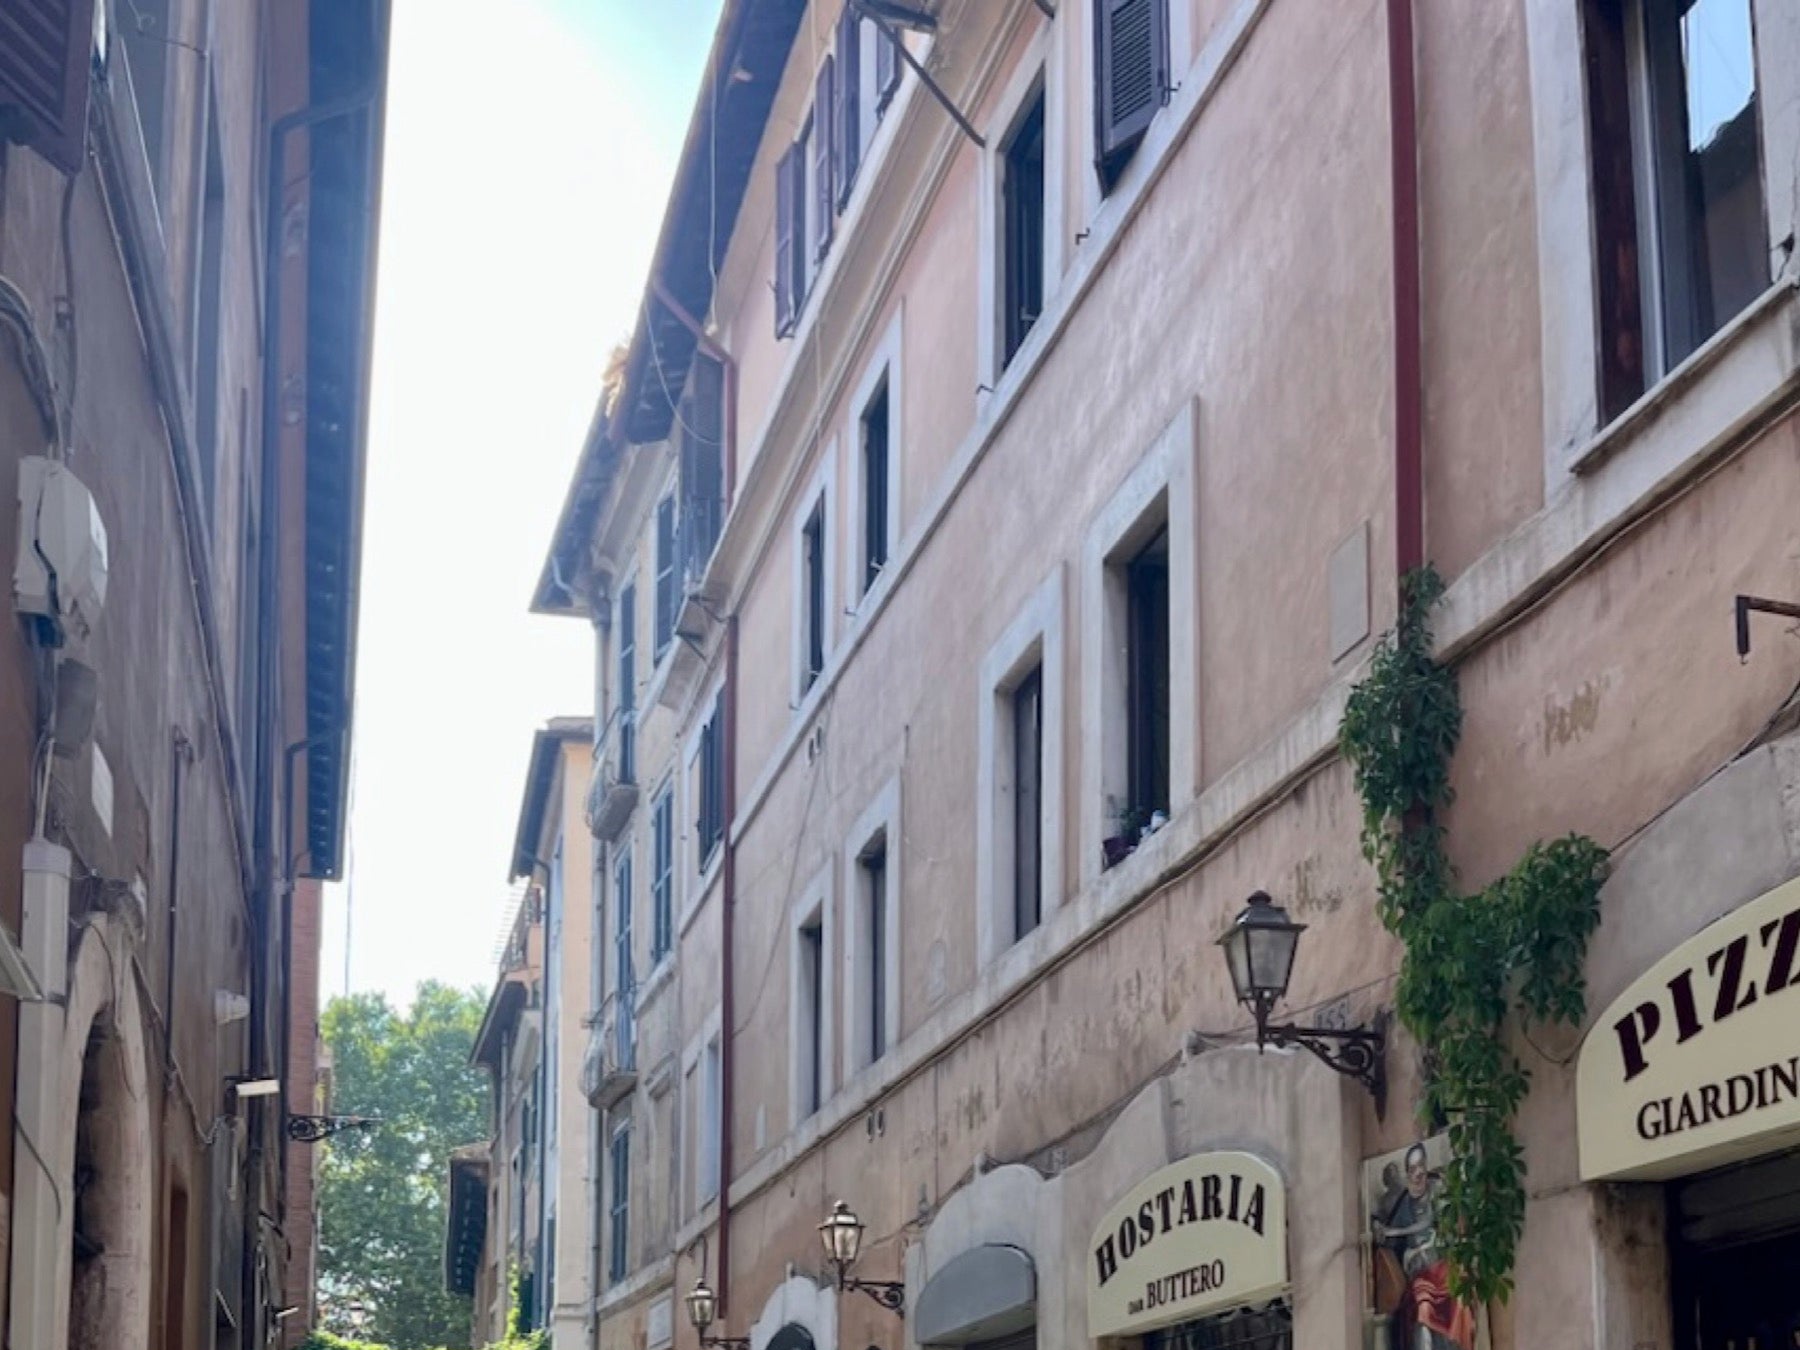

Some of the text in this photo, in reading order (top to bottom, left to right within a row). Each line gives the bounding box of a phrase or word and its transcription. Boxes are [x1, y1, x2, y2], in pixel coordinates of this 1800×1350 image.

[1613, 908, 1800, 1083] PIZZ
[1636, 1056, 1800, 1141] GIARDIN
[1095, 1173, 1265, 1288] HOSTARIA
[1146, 1259, 1225, 1309] BUTTERO
